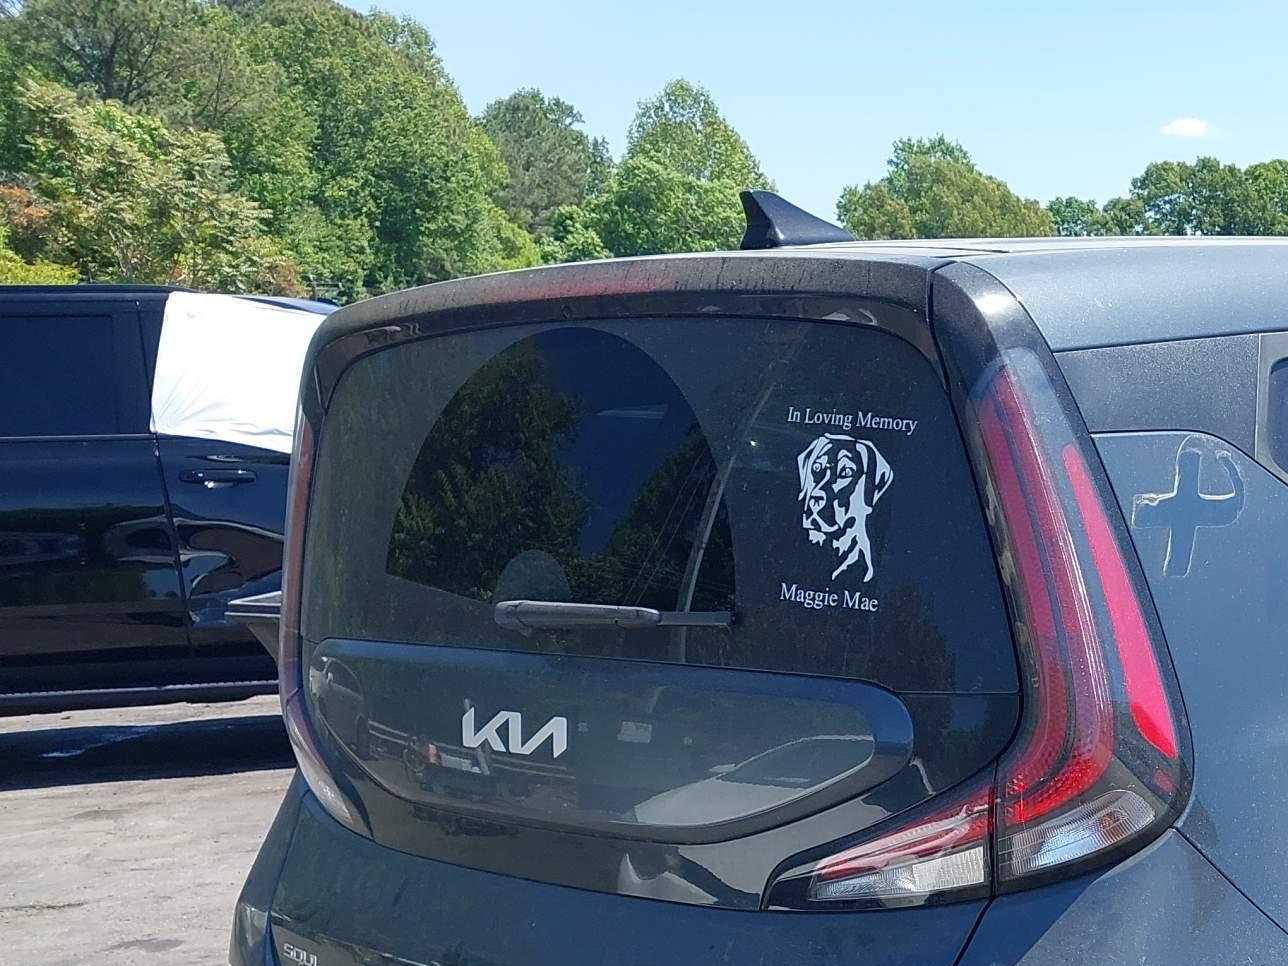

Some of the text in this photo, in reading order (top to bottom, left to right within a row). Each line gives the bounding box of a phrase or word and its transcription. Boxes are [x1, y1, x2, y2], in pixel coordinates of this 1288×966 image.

[787, 407, 918, 435] In Loving Memory
[780, 582, 879, 612] Maggie Mae
[462, 707, 568, 759] KIA
